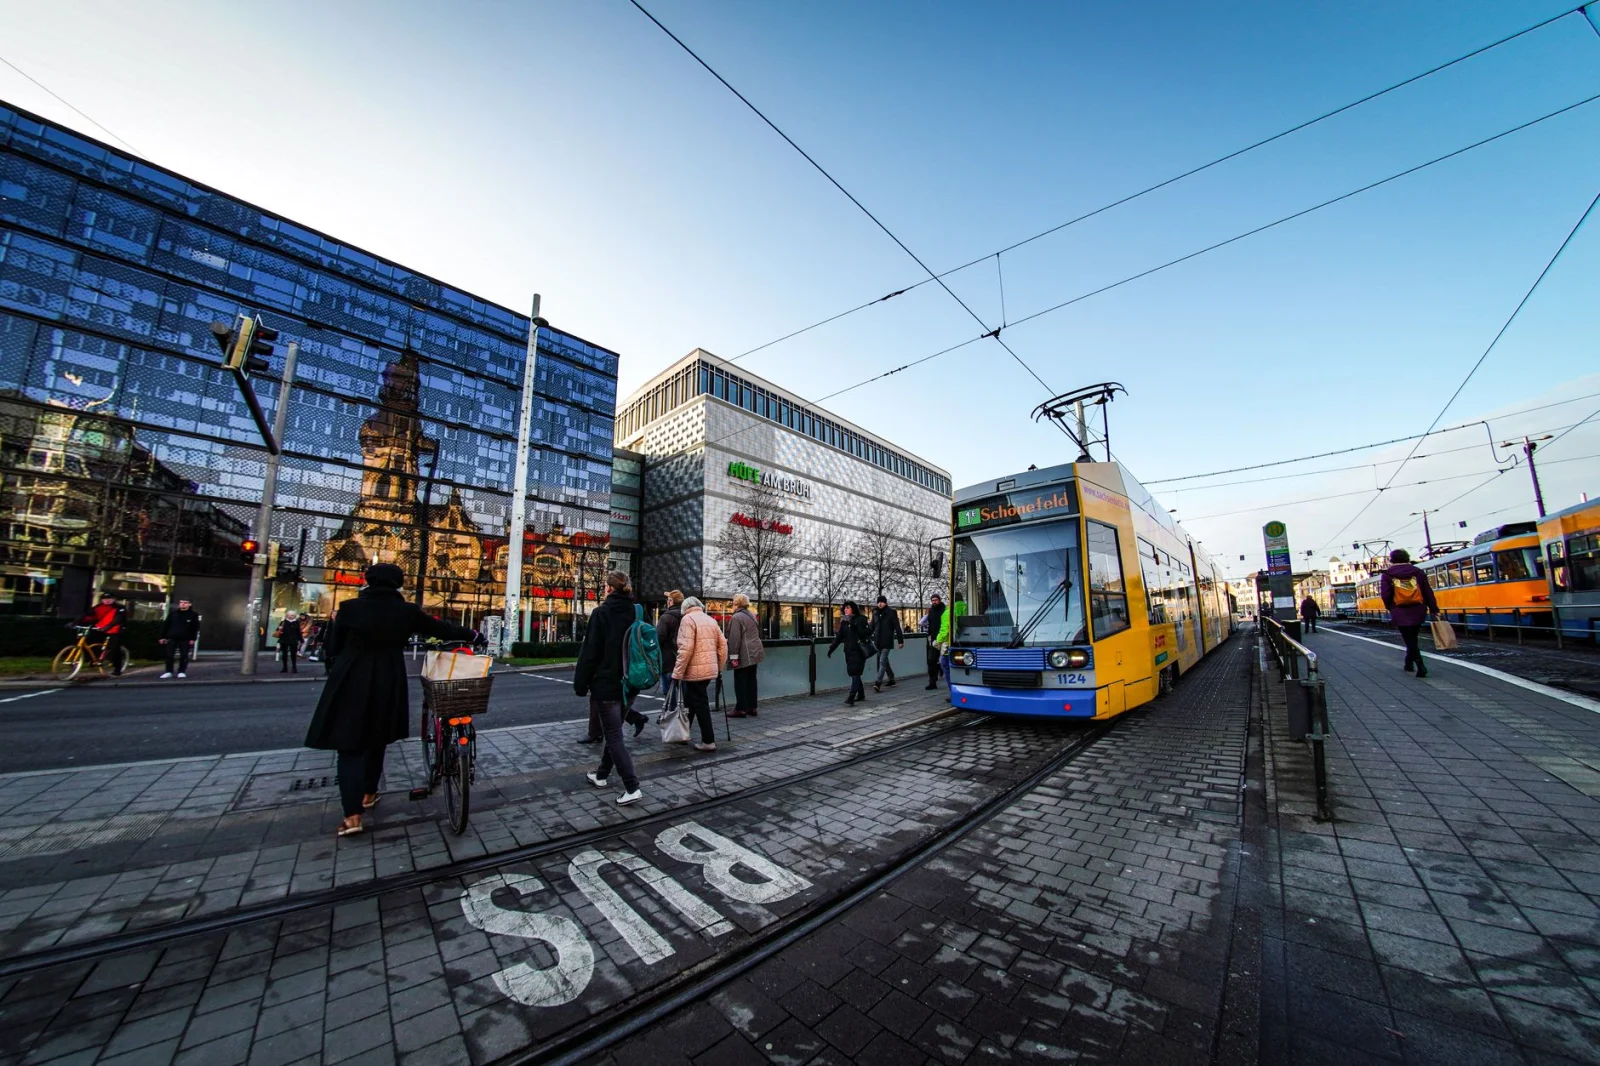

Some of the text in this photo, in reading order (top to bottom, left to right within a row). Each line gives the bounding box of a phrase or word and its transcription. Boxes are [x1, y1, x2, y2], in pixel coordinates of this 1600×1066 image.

[762, 471, 780, 490] AM
[1057, 673, 1087, 684] 1124
[460, 821, 814, 1007] BUS
